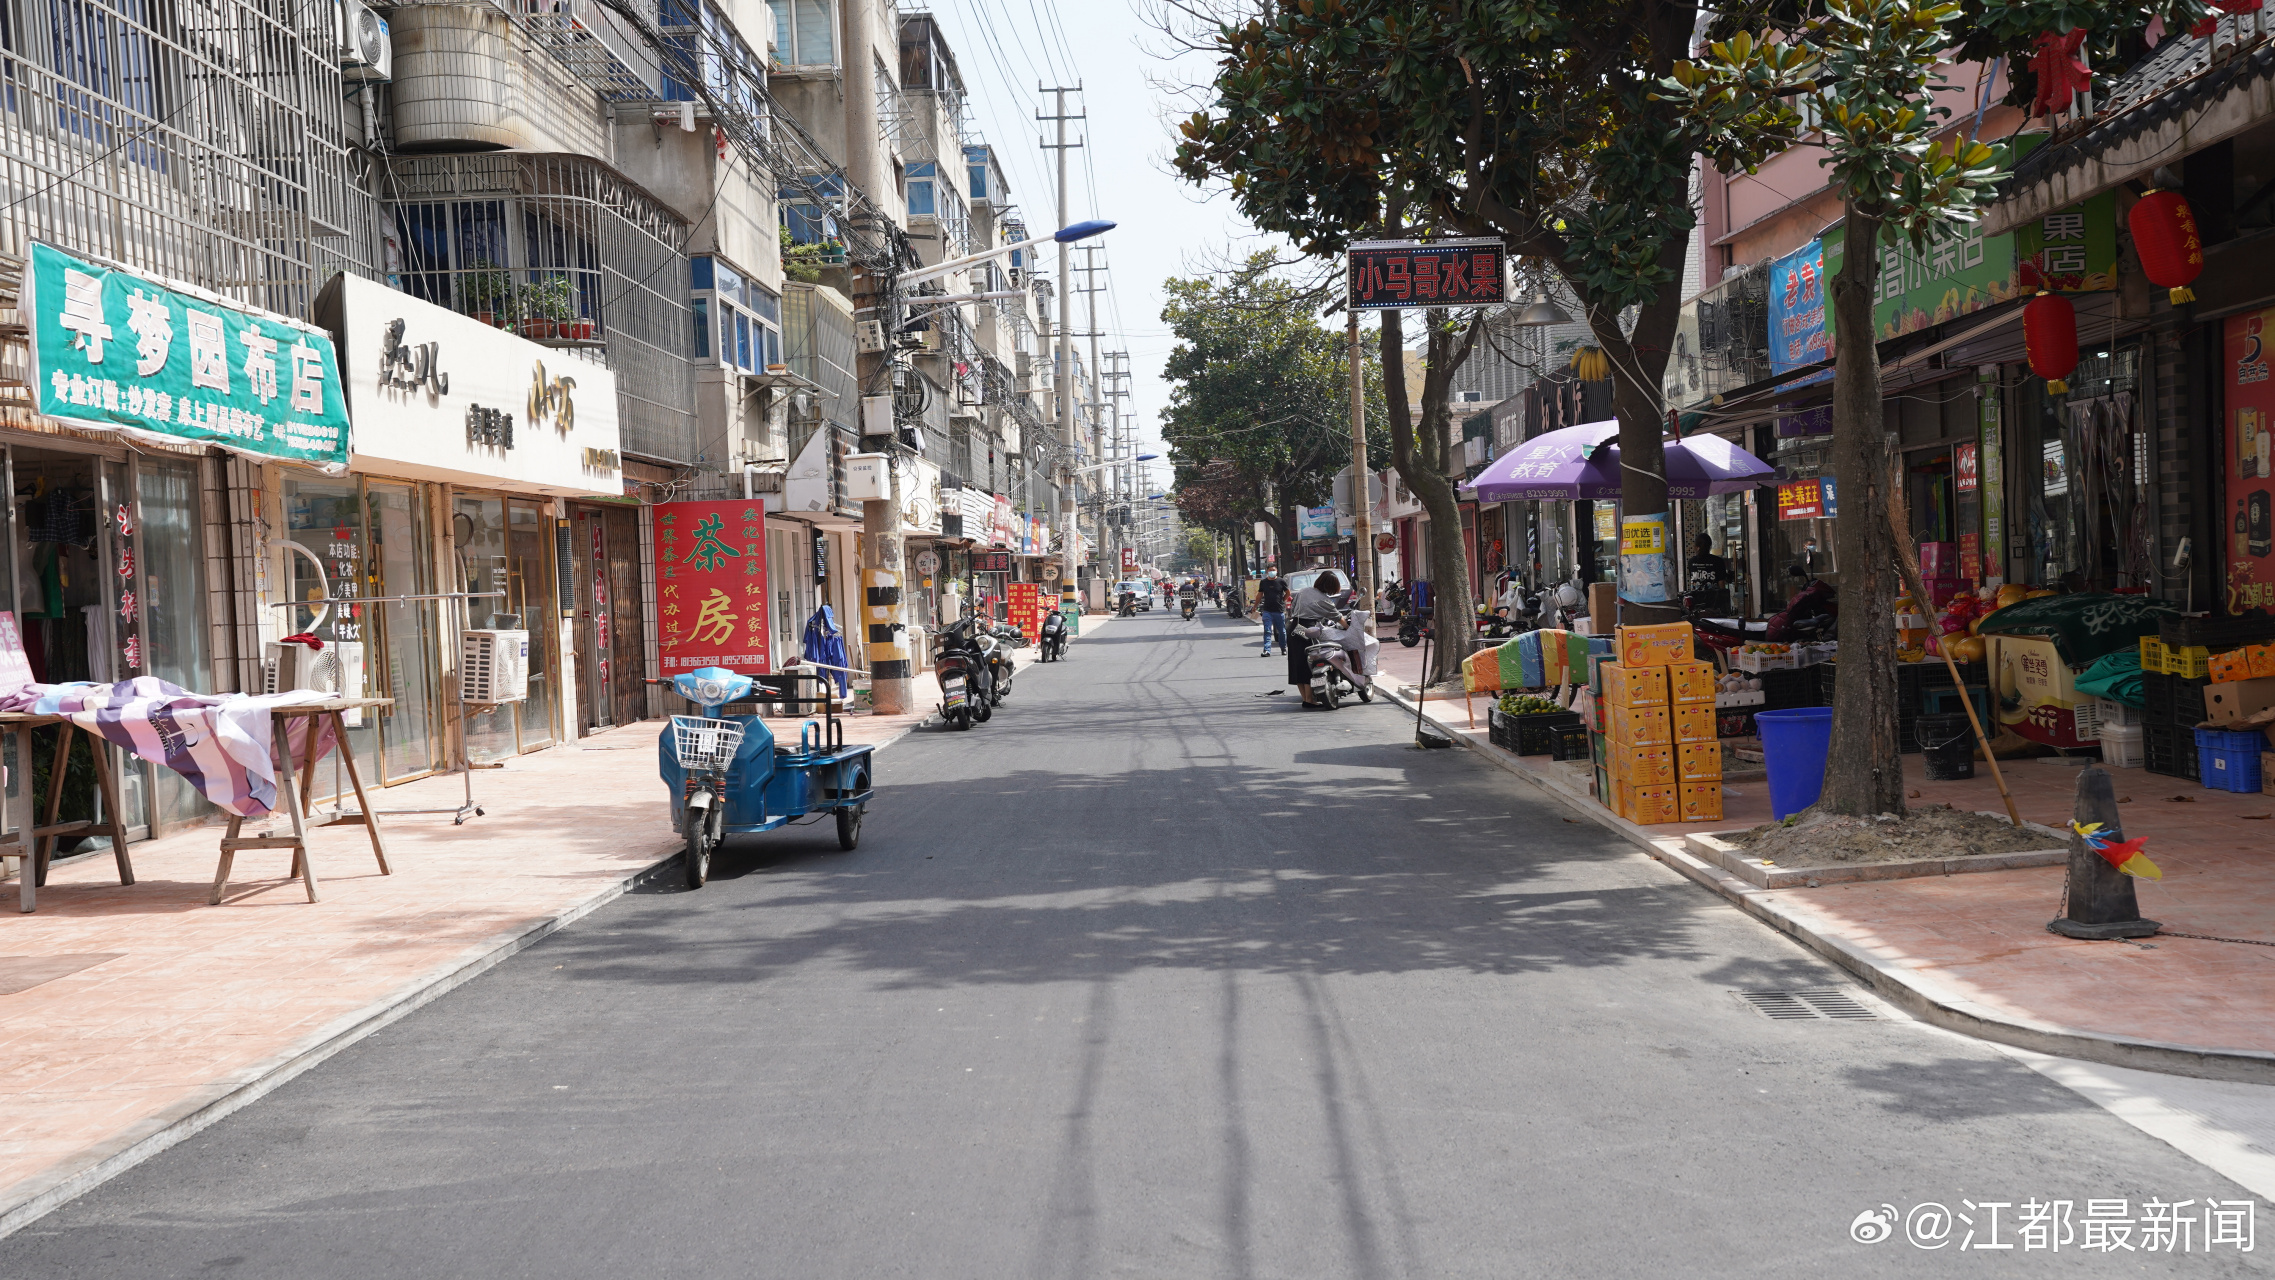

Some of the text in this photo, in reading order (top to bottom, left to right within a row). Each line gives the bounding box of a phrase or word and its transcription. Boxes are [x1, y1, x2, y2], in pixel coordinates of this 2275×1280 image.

[2043, 203, 2086, 273] 果店
[1356, 252, 1499, 300] 小马哥水果
[59, 267, 325, 415] 寻梦园布店
[1509, 461, 1562, 479] 教育
[1523, 444, 1574, 460] 星火
[1669, 486, 1696, 496] 9995
[345, 582, 358, 597] 美甲
[659, 511, 682, 652] 世界茶王 代办过户
[683, 512, 741, 646] 茶房
[741, 507, 764, 648] 安化黑茶 红心家政
